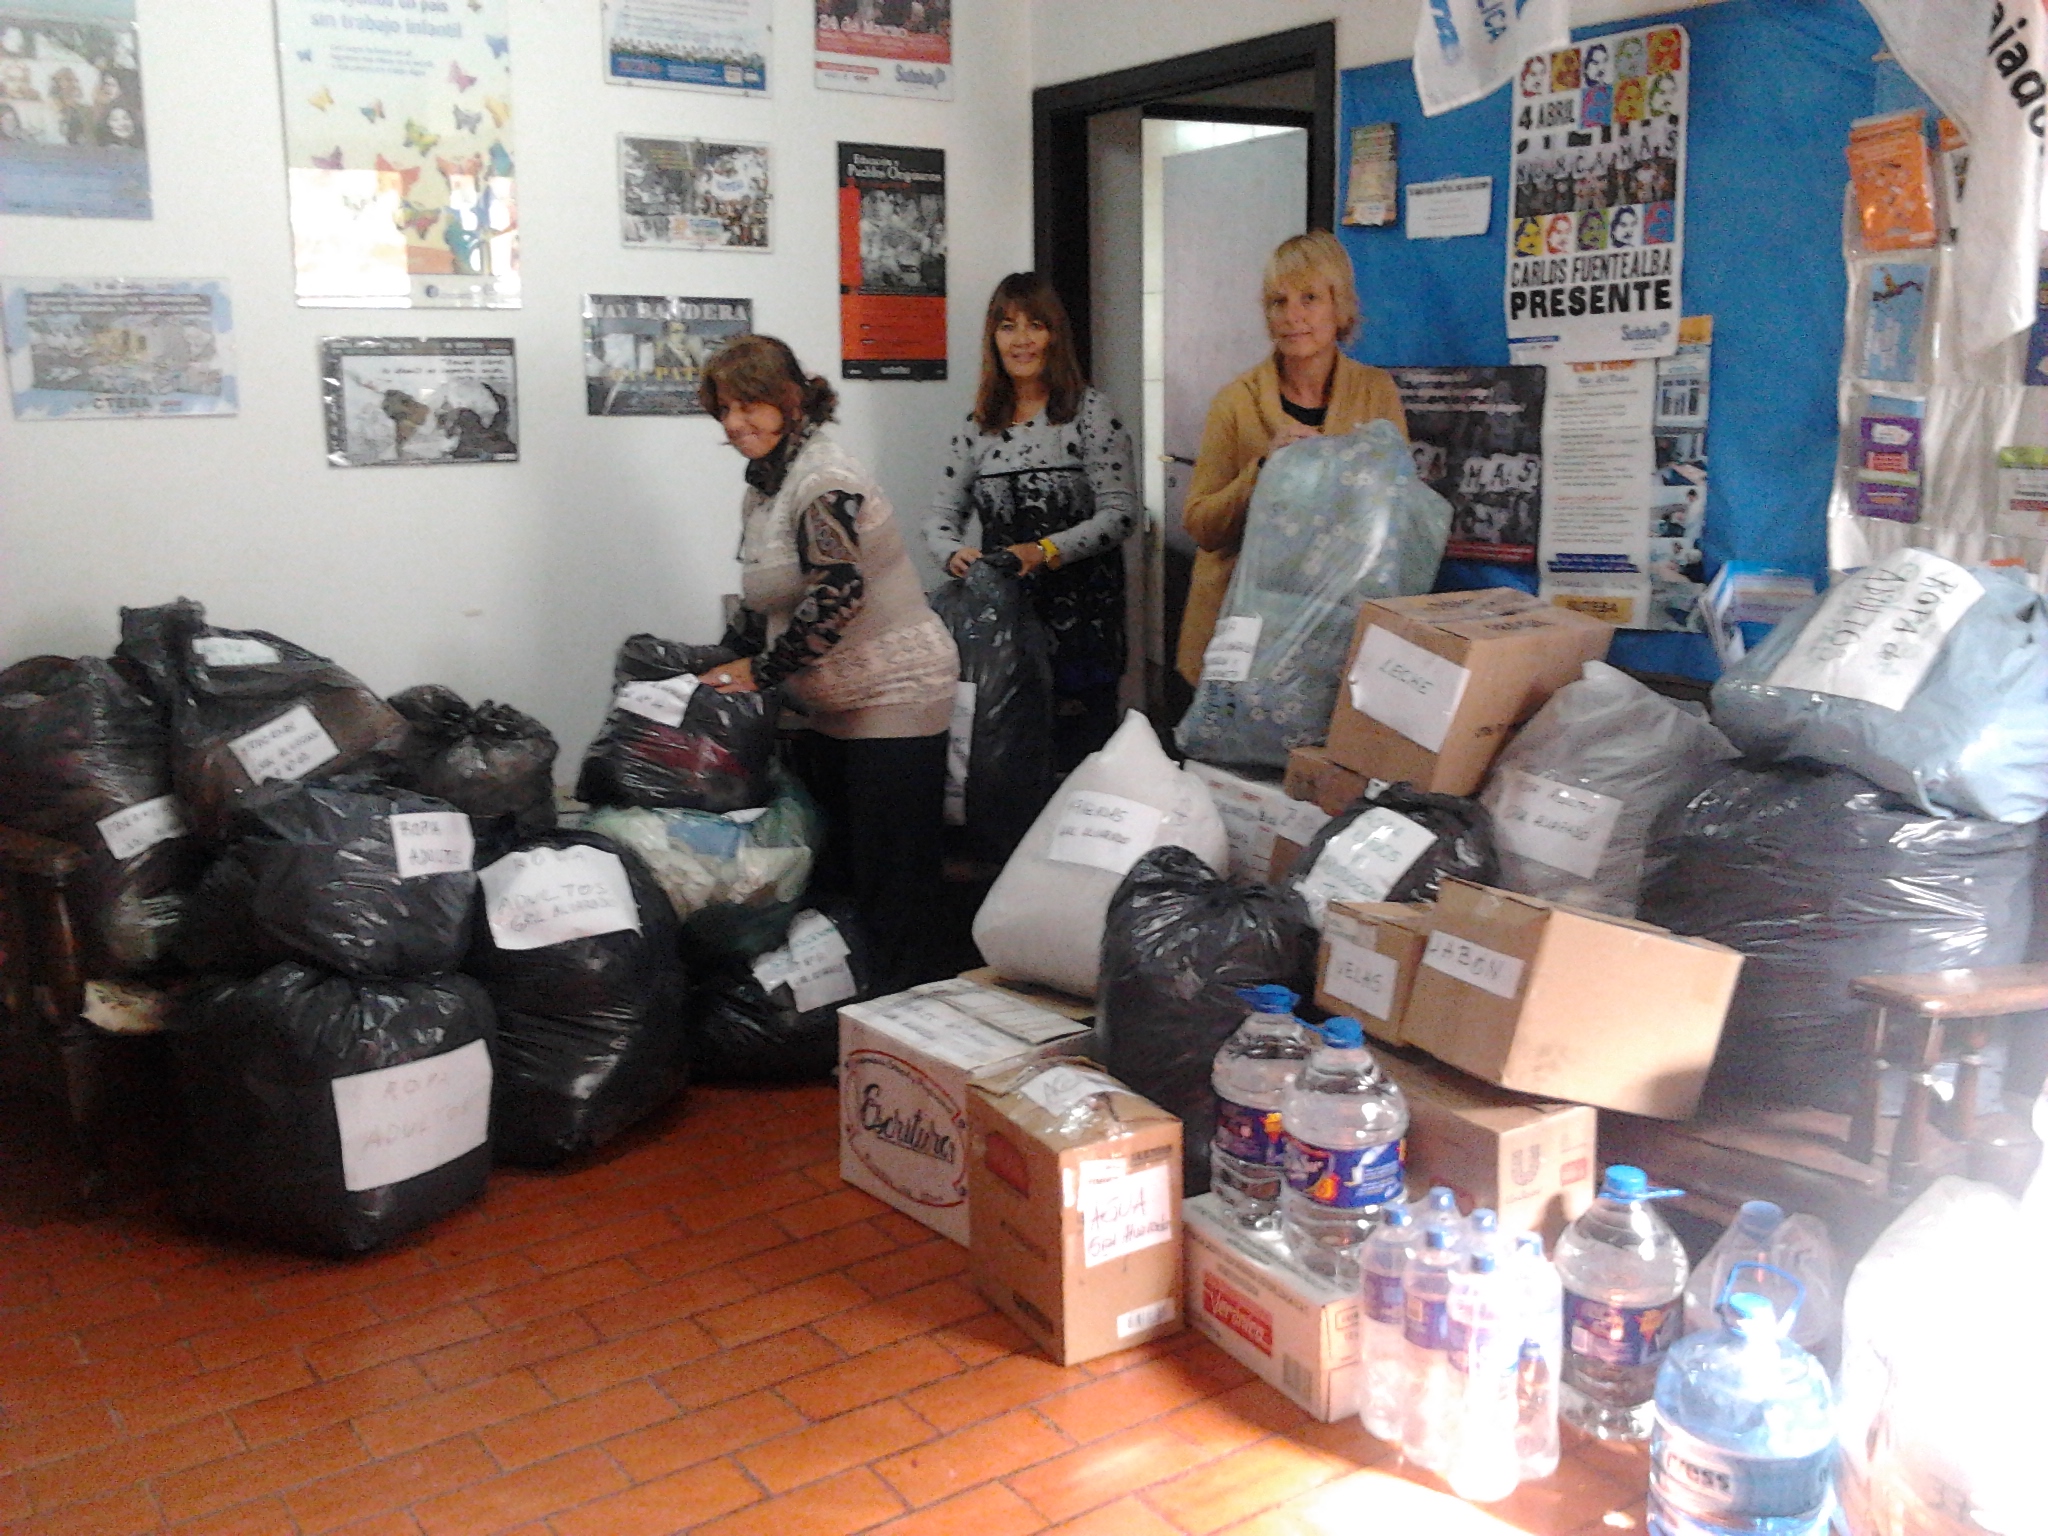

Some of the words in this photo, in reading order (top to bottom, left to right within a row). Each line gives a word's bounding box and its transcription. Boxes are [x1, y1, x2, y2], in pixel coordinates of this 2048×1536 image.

[1519, 105, 1532, 130] 4
[1537, 98, 1576, 129] ABRIL
[1510, 258, 1568, 289] CARLOS
[1572, 248, 1672, 284] FUENTEALBA
[1510, 278, 1673, 321] PRESENTE
